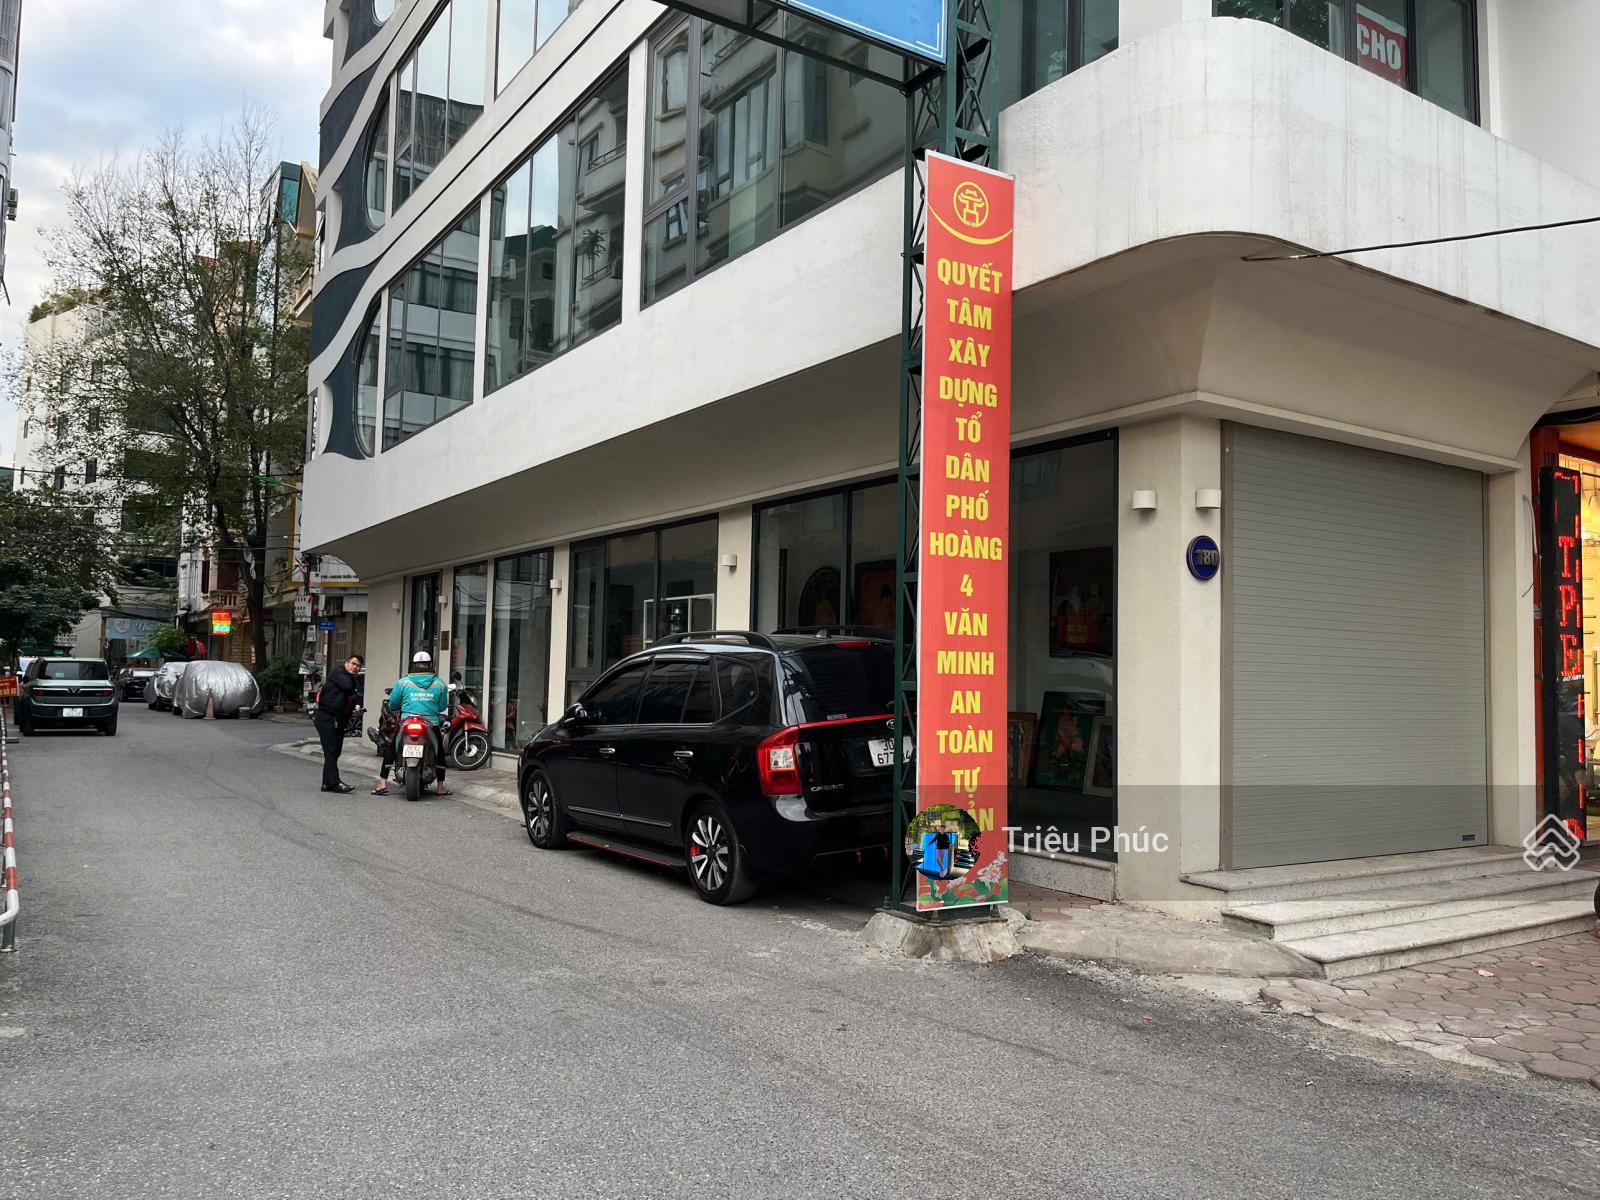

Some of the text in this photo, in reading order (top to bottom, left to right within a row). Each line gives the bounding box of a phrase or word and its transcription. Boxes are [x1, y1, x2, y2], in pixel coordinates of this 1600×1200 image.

[1357, 23, 1401, 70] CHO
[937, 257, 1003, 294] QUYẾT
[946, 297, 992, 330] TÂM
[948, 336, 990, 368] XÂY
[939, 375, 997, 408] DỰNG
[955, 411, 983, 443] TỔ
[945, 452, 990, 483] DÂN
[946, 490, 989, 521] PHỐ
[929, 529, 1002, 561] HOÀNG
[960, 574, 974, 597] 4
[944, 607, 988, 637] VĂN
[937, 650, 994, 675] MINH
[950, 690, 981, 714] AN
[936, 724, 993, 754] TOÀN
[951, 766, 981, 799] TỰ
